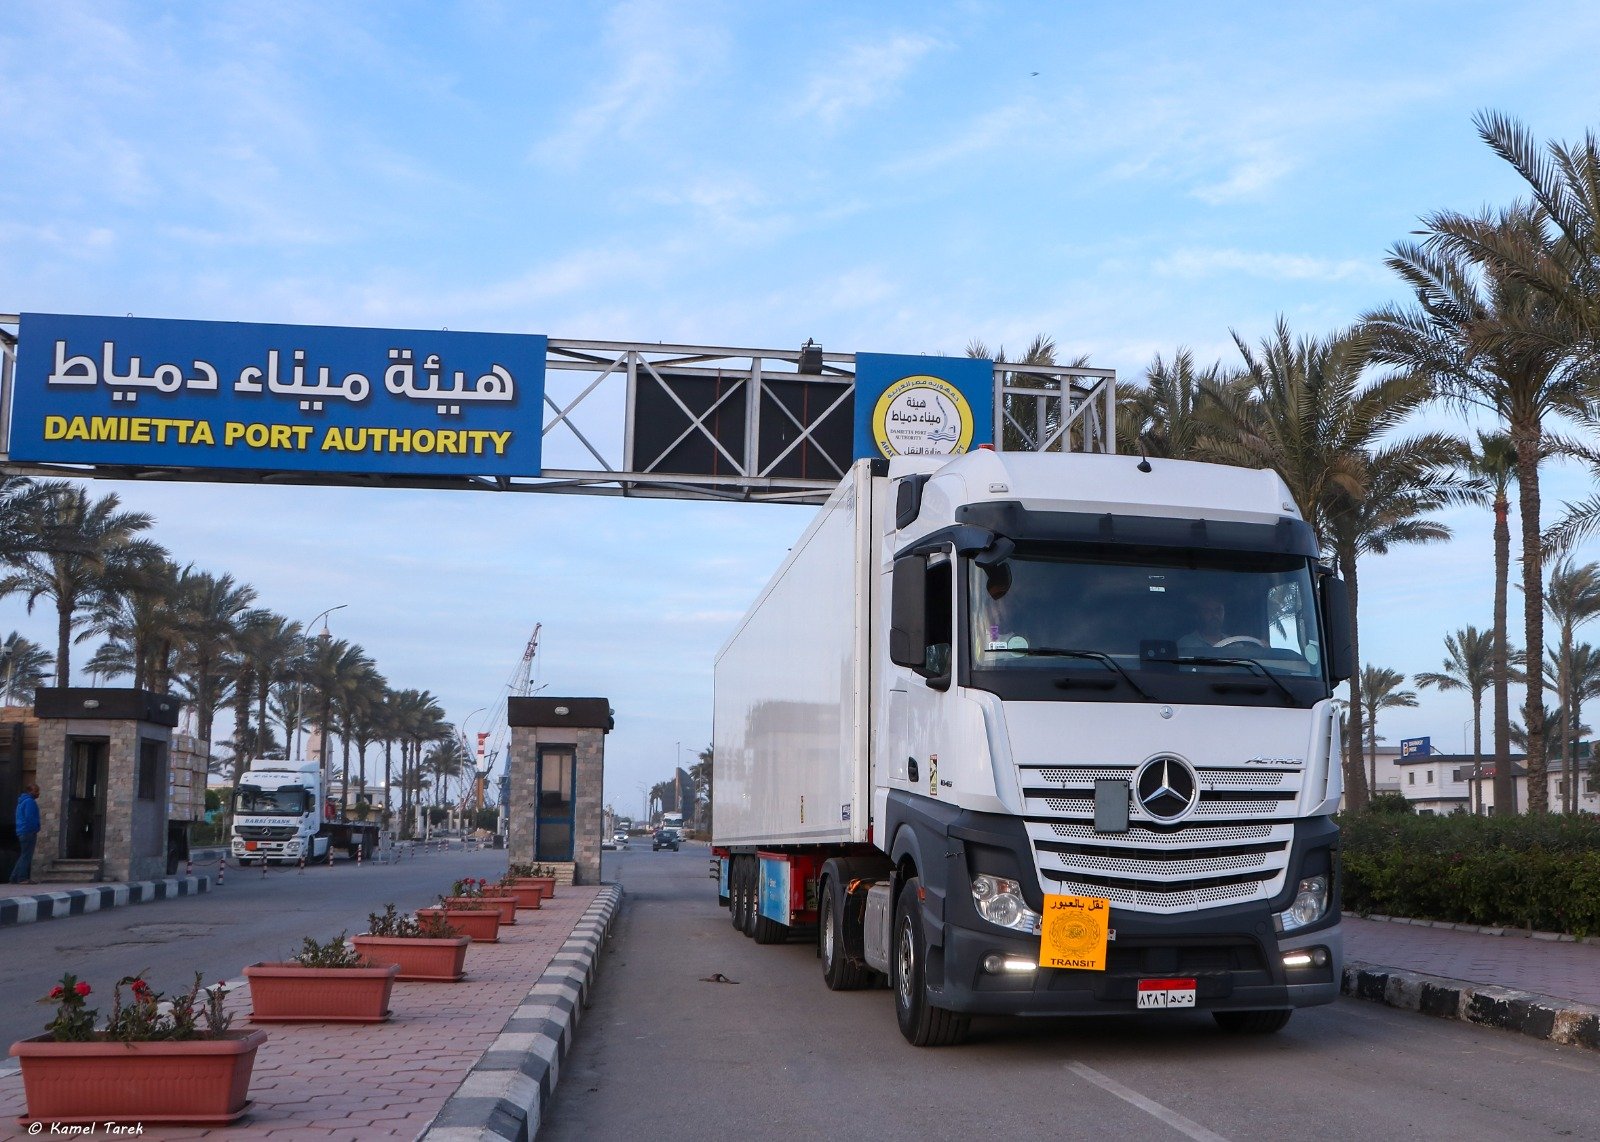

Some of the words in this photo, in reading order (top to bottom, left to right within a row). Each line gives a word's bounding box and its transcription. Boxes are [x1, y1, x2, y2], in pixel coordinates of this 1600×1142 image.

[48, 340, 219, 402] دمياط
[234, 349, 371, 411] ميناء
[384, 348, 515, 415] هيئة
[906, 396, 927, 411] هيئة
[891, 410, 918, 425] دمياط
[919, 411, 941, 426] ميناء
[44, 415, 215, 445] DAMIETTA
[224, 422, 314, 450] PORT
[321, 427, 513, 454] AUTHORITY
[1245, 756, 1303, 765] ACTROS
[1050, 898, 1085, 909] بالعبور
[1088, 898, 1104, 911] نقل
[1051, 958, 1096, 967] TRANSIT
